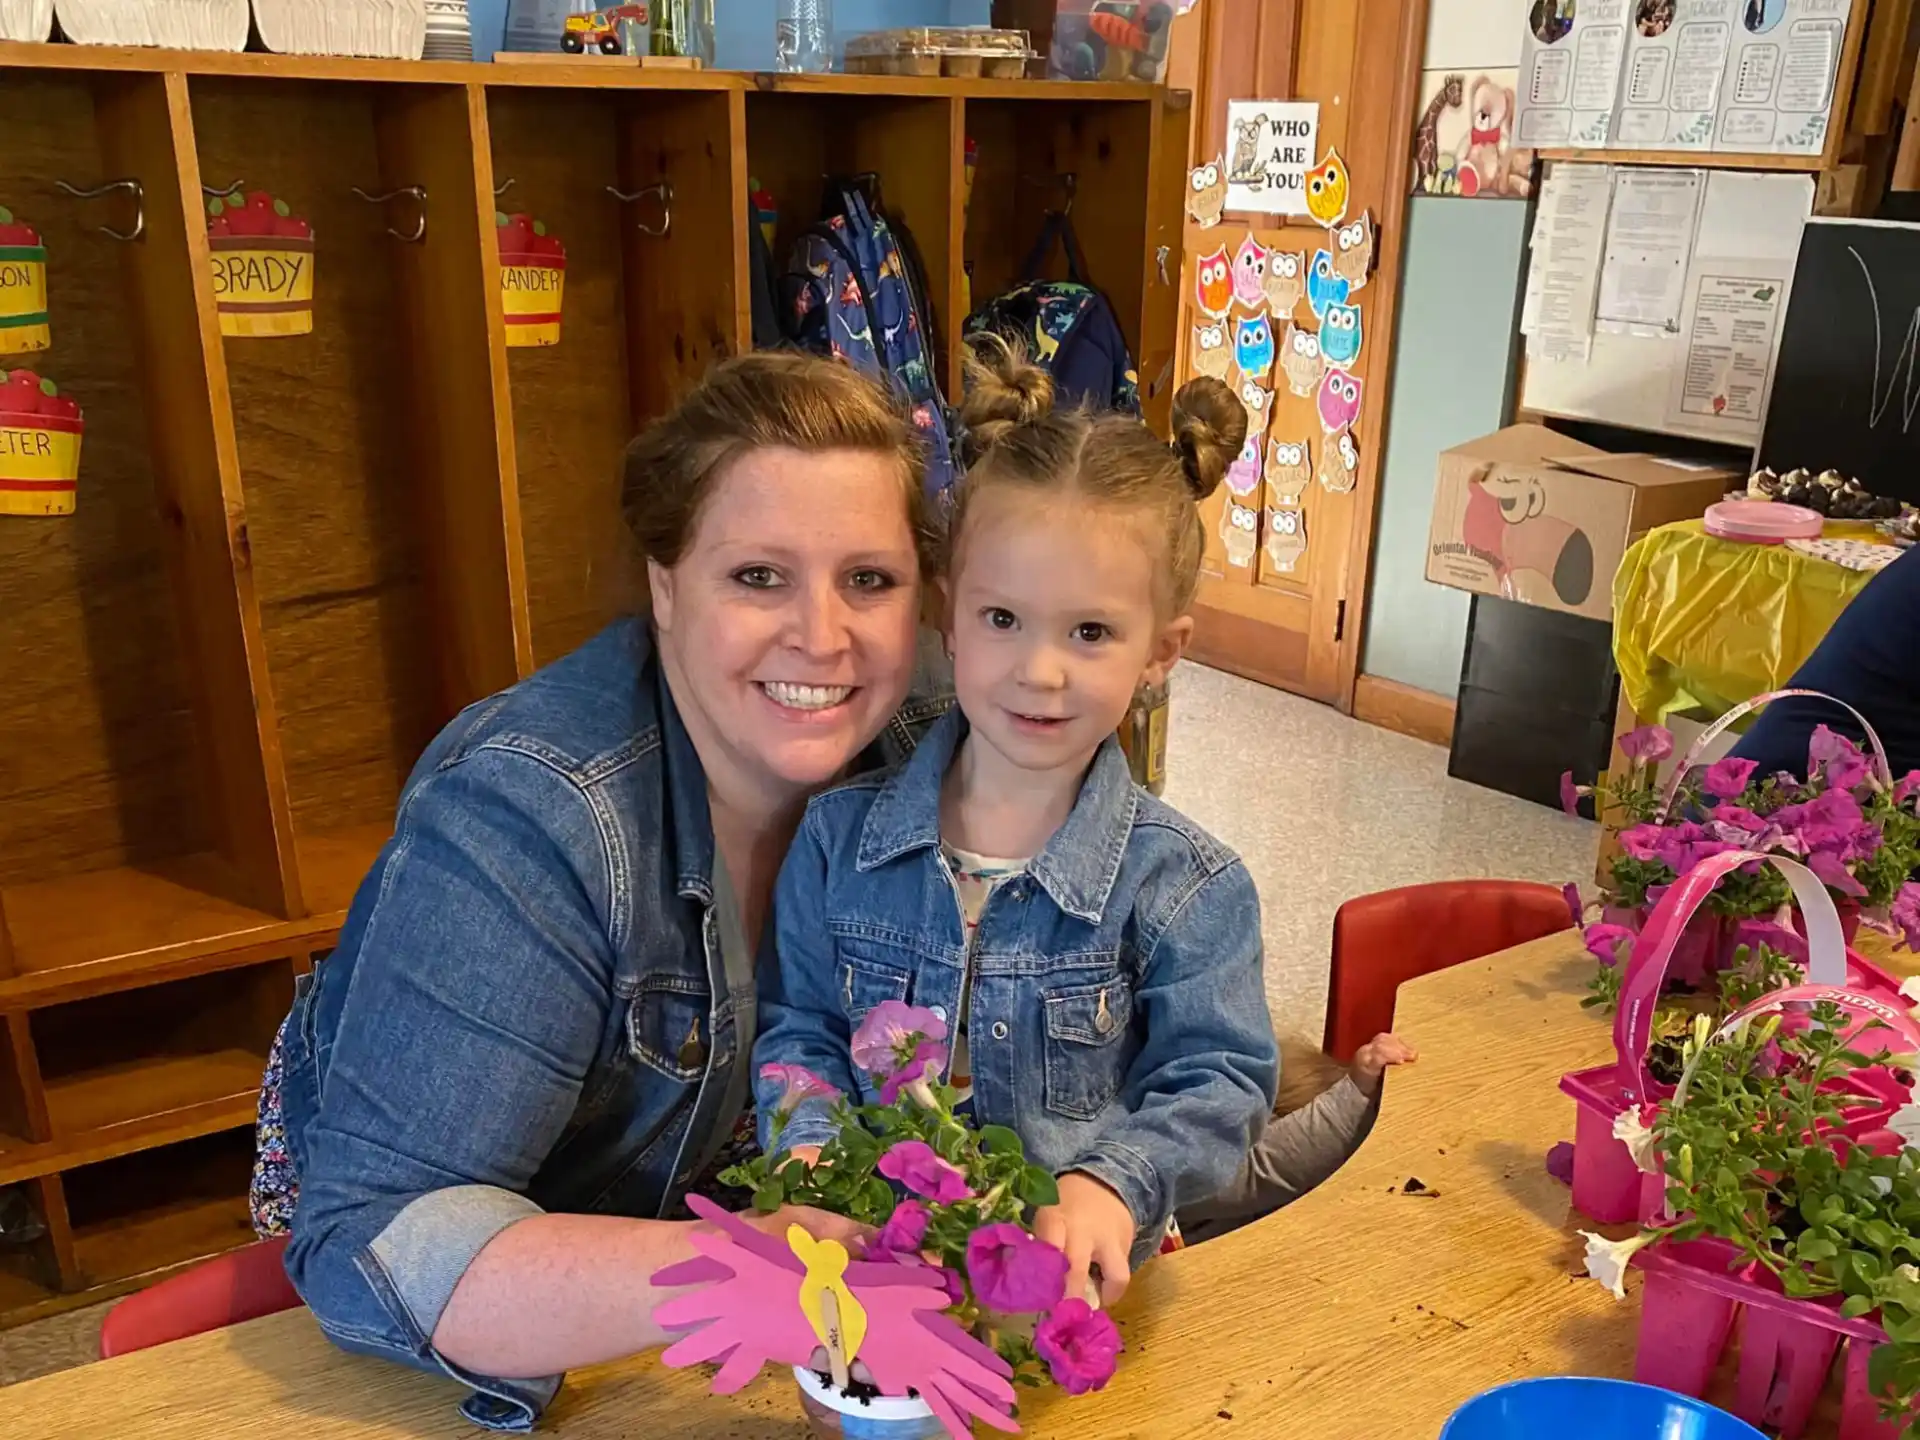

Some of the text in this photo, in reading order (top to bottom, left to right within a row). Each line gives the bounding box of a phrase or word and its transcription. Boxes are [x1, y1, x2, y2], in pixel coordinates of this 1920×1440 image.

[1270, 120, 1310, 137] WHO
[1270, 146, 1306, 163] ARE
[211, 256, 303, 298] BRADY
